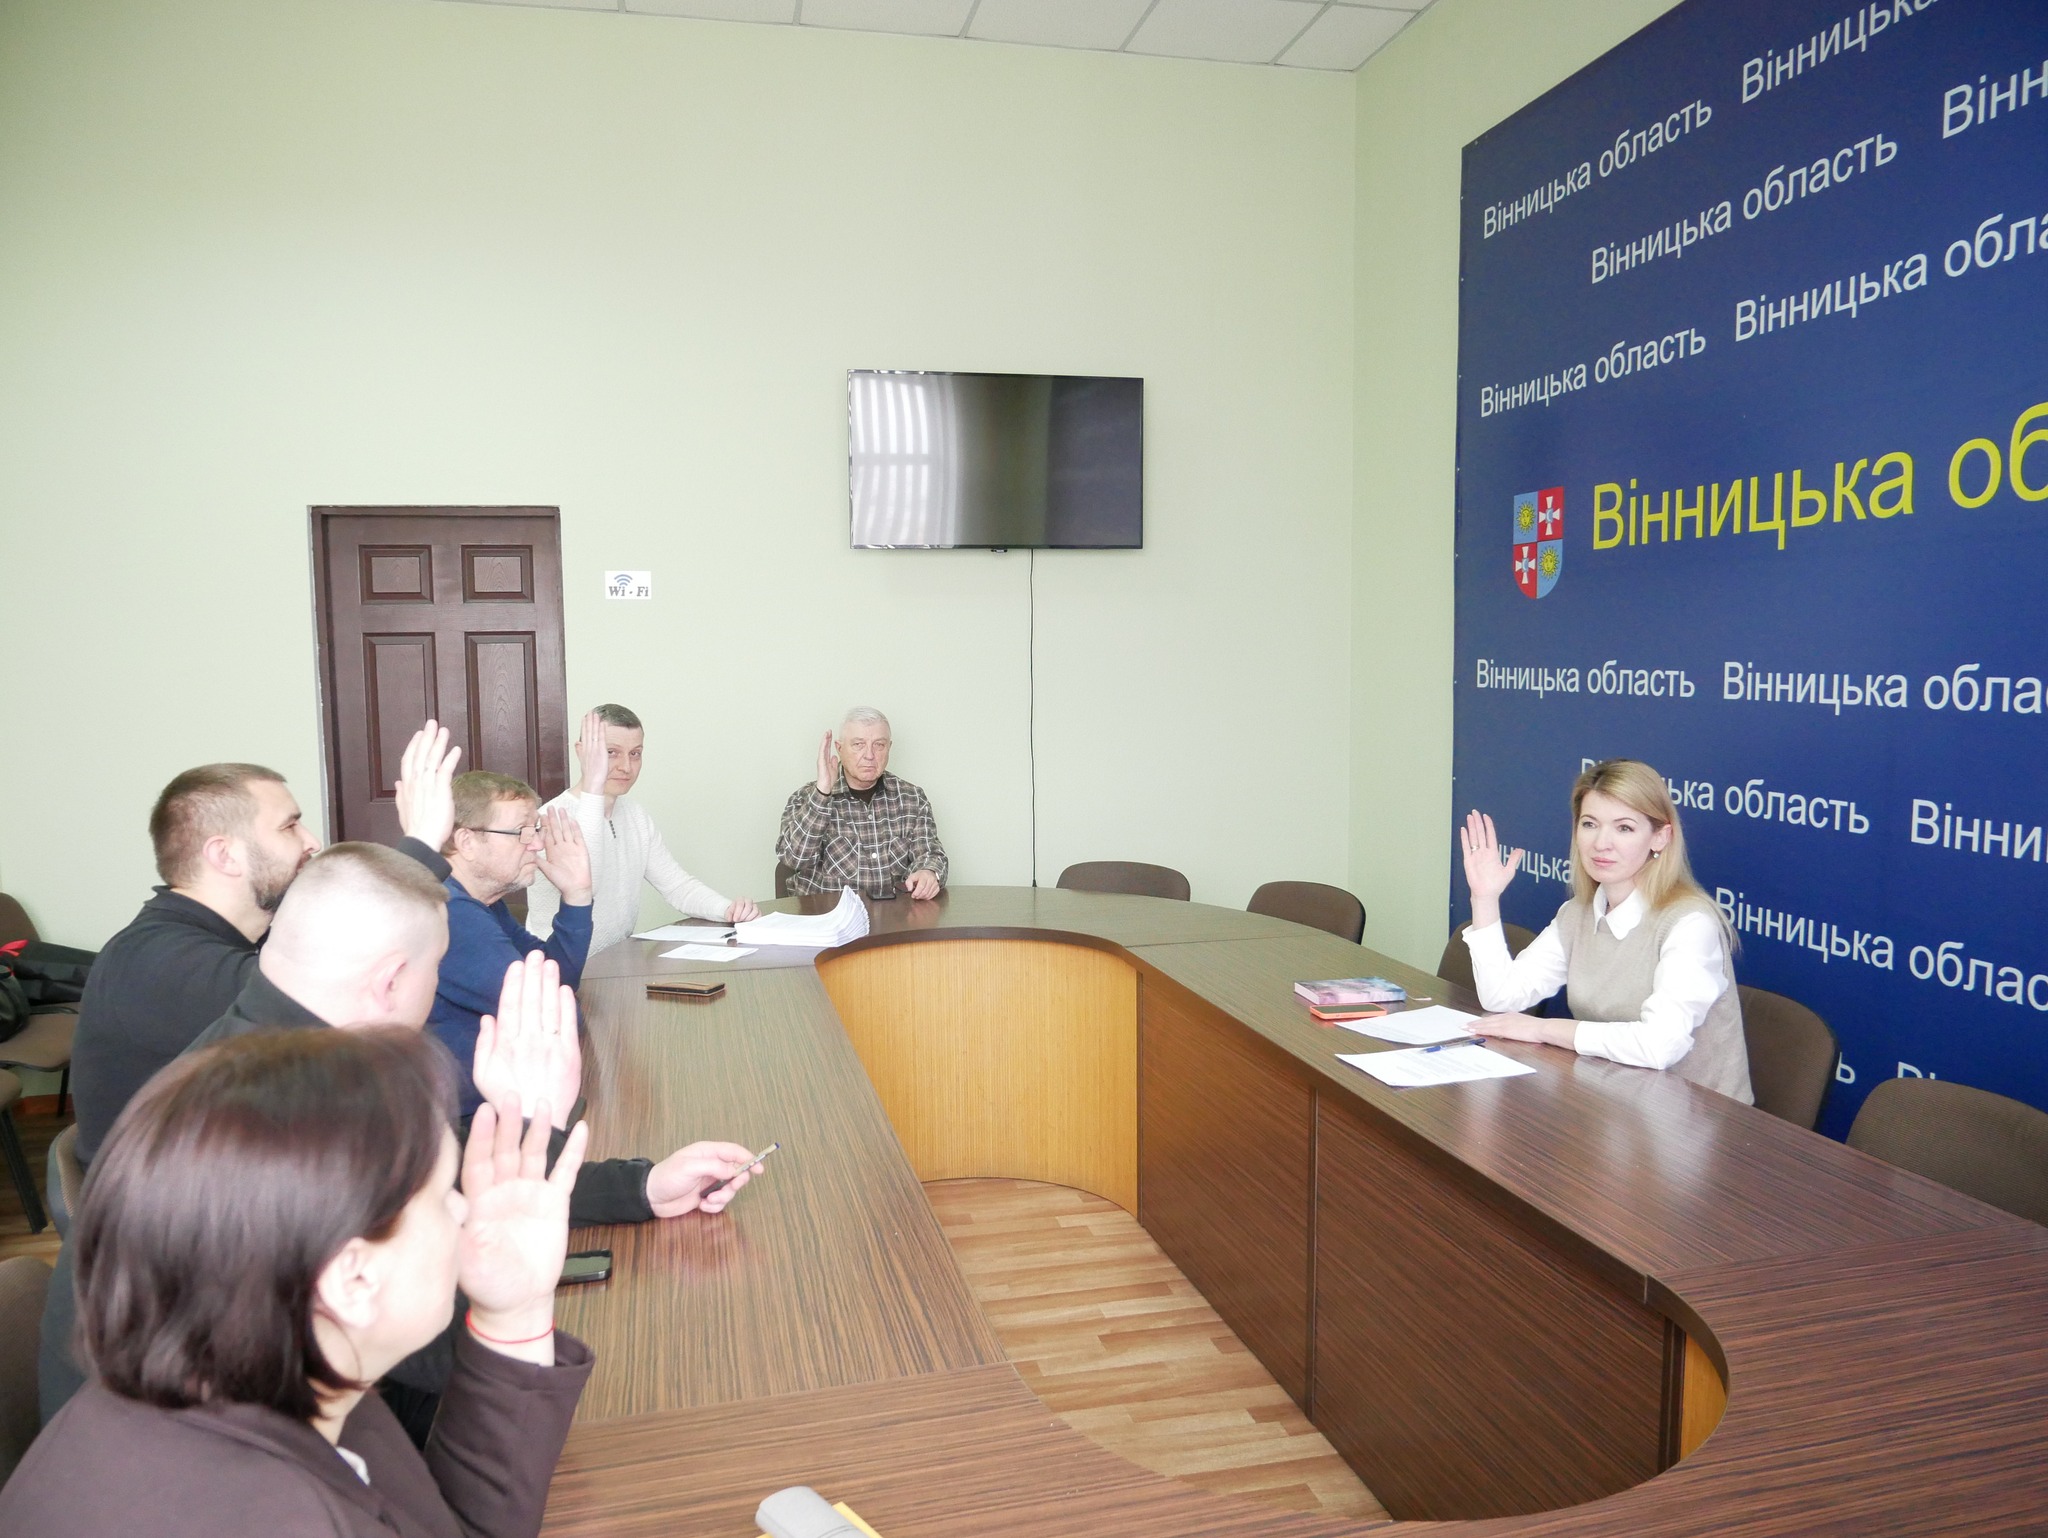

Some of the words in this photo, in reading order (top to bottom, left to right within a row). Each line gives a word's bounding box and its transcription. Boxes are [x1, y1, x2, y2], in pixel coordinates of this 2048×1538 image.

[1742, 0, 1938, 104] Вінницьк
[1942, 58, 2048, 139] Вінн
[1483, 161, 1591, 239] Вінницька
[1599, 98, 1713, 178] область
[1591, 200, 1732, 284] Вінницька
[1743, 131, 1898, 220] область
[1735, 252, 1927, 342] Вінницька
[1481, 362, 1587, 418] Вінницька
[1594, 325, 1706, 383] область
[1592, 450, 1915, 551] Вінницька
[1948, 400, 2048, 509] об
[1476, 658, 1580, 699] Вінницька
[1587, 659, 1696, 698] область
[1723, 661, 1908, 716] Вінницька
[1923, 663, 2048, 714] обла
[1724, 778, 1870, 834] область
[1910, 798, 2048, 864] Вінни
[1715, 886, 1894, 970] Вінницька
[1909, 941, 2048, 1012] облас
